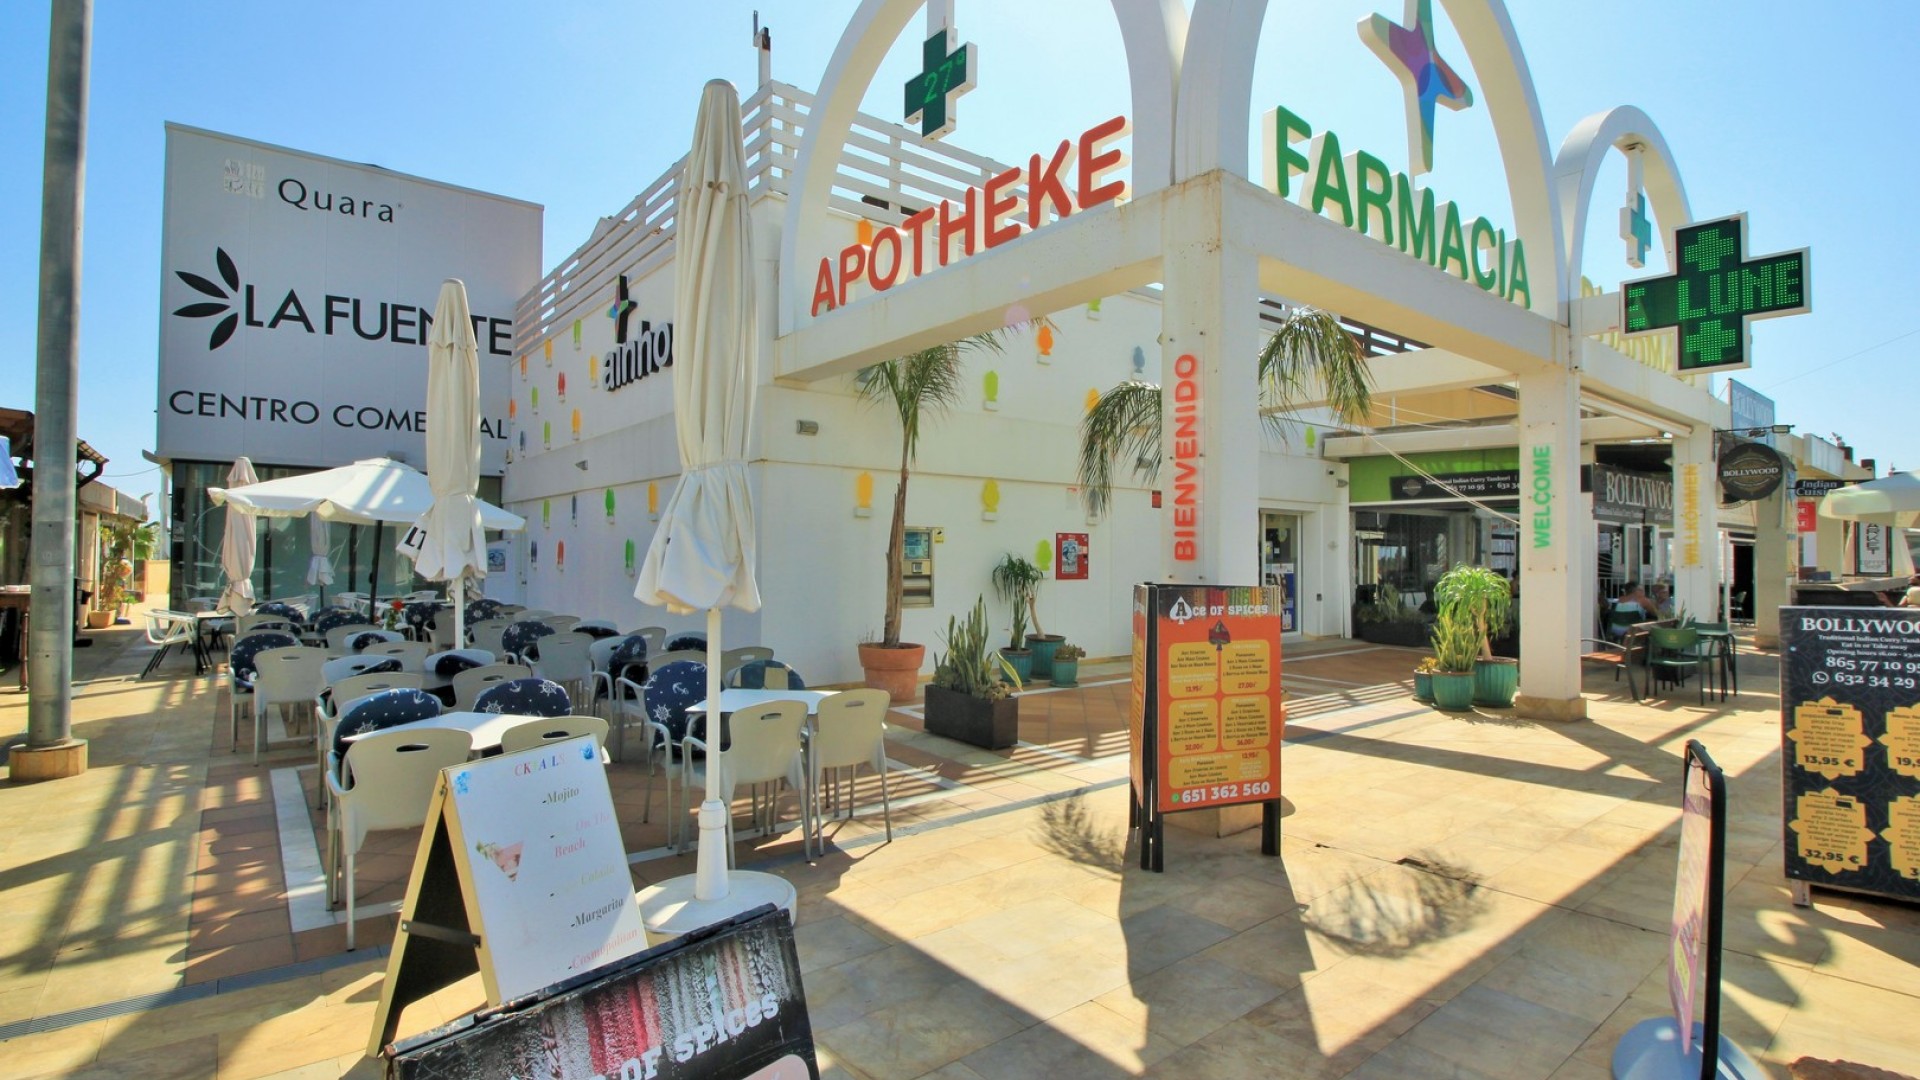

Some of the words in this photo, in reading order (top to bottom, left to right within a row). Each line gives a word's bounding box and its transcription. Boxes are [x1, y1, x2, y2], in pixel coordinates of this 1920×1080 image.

[278, 178, 394, 223] Quara
[811, 115, 1127, 317] APOTHEKE
[1276, 105, 1532, 310] FARMACIA
[245, 284, 315, 333] LA
[603, 320, 674, 393] ainho
[169, 390, 320, 425] CENTRO
[332, 404, 508, 440] COMEAL
[1174, 353, 1198, 561] BIENVENIDO
[1723, 467, 1779, 477] BOLLYWOOD
[1533, 445, 1552, 549] WELCOME
[1605, 471, 1673, 511] BOLLYWOO
[1796, 487, 1827, 496] Cuisi
[1802, 480, 1838, 488] Indian
[1825, 656, 1856, 670] 865
[1860, 660, 1880, 672] 77
[1883, 661, 1901, 670] 10
[1834, 672, 1865, 686] 632
[1868, 675, 1889, 688] 34
[1894, 677, 1915, 689] 29
[1804, 754, 1840, 766] 13,95
[1843, 758, 1855, 768] €
[1182, 788, 1206, 803] 651
[1211, 784, 1238, 800] 362
[1243, 781, 1270, 797] 560
[1804, 848, 1844, 862] 32,95
[1848, 855, 1860, 864] €
